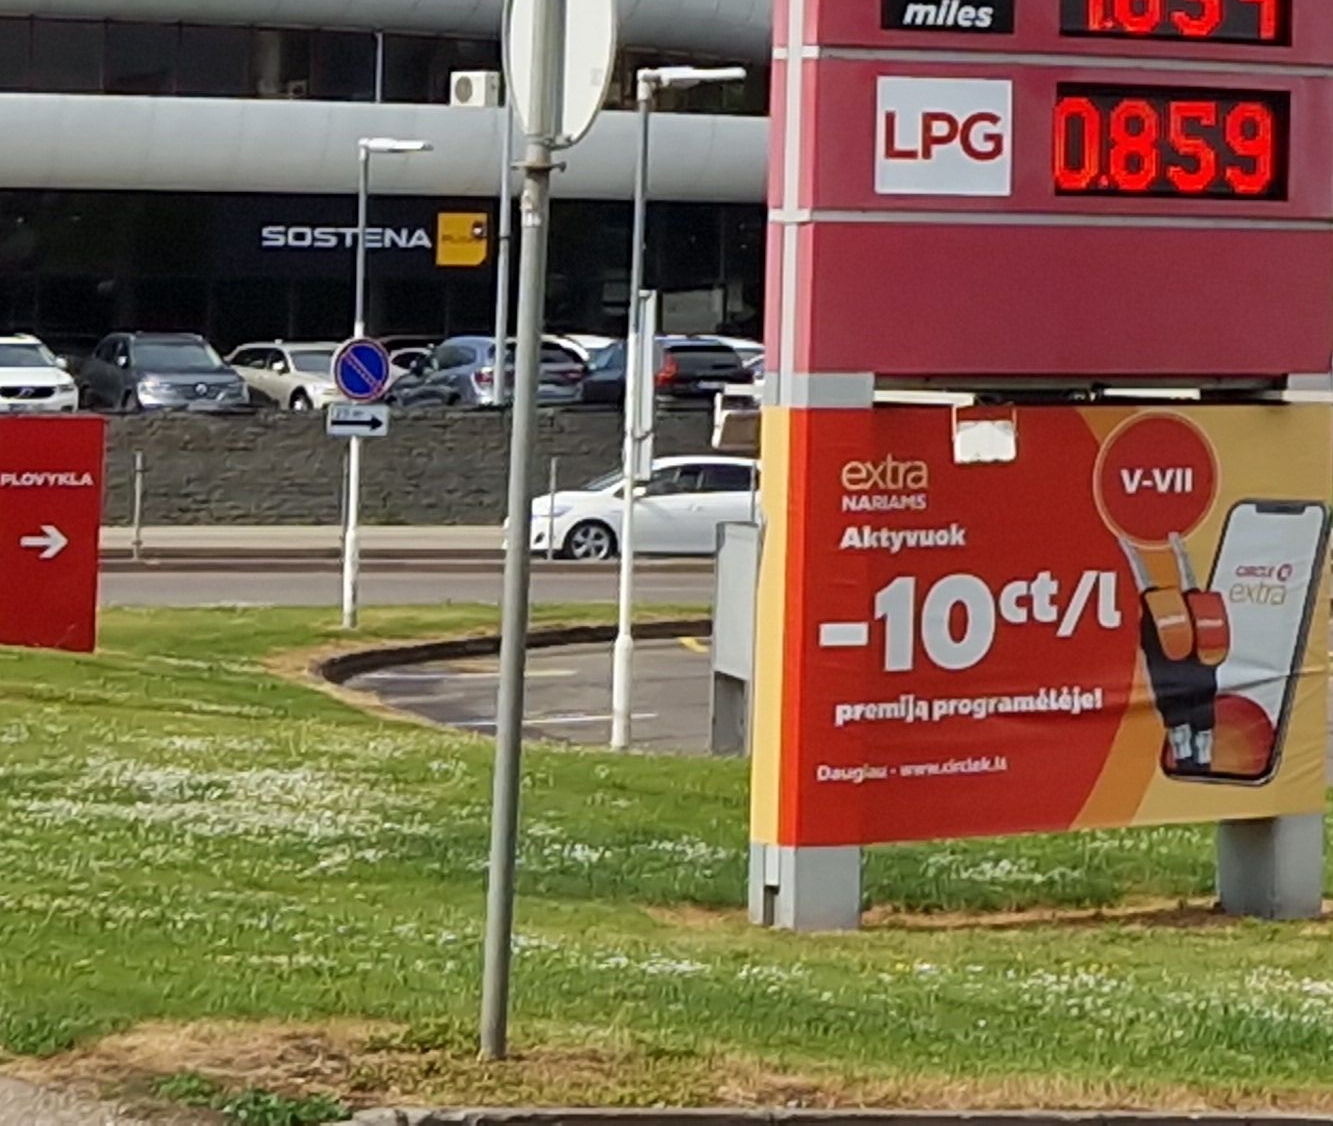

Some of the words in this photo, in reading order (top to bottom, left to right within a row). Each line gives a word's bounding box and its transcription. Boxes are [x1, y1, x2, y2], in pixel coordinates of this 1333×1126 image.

[902, 1, 994, 30] miles
[883, 111, 1003, 162] LPG
[261, 226, 432, 249] SOSTENA
[841, 453, 929, 491] extra
[1120, 467, 1194, 494] V-VII
[842, 494, 927, 512] NARIAMS
[839, 524, 967, 554] Aktyvuok
[1229, 581, 1287, 605] extra
[932, 686, 1103, 719] programėlėje!
[816, 764, 888, 784] Daugiau
[900, 756, 1008, 776] www.circlek.lt
